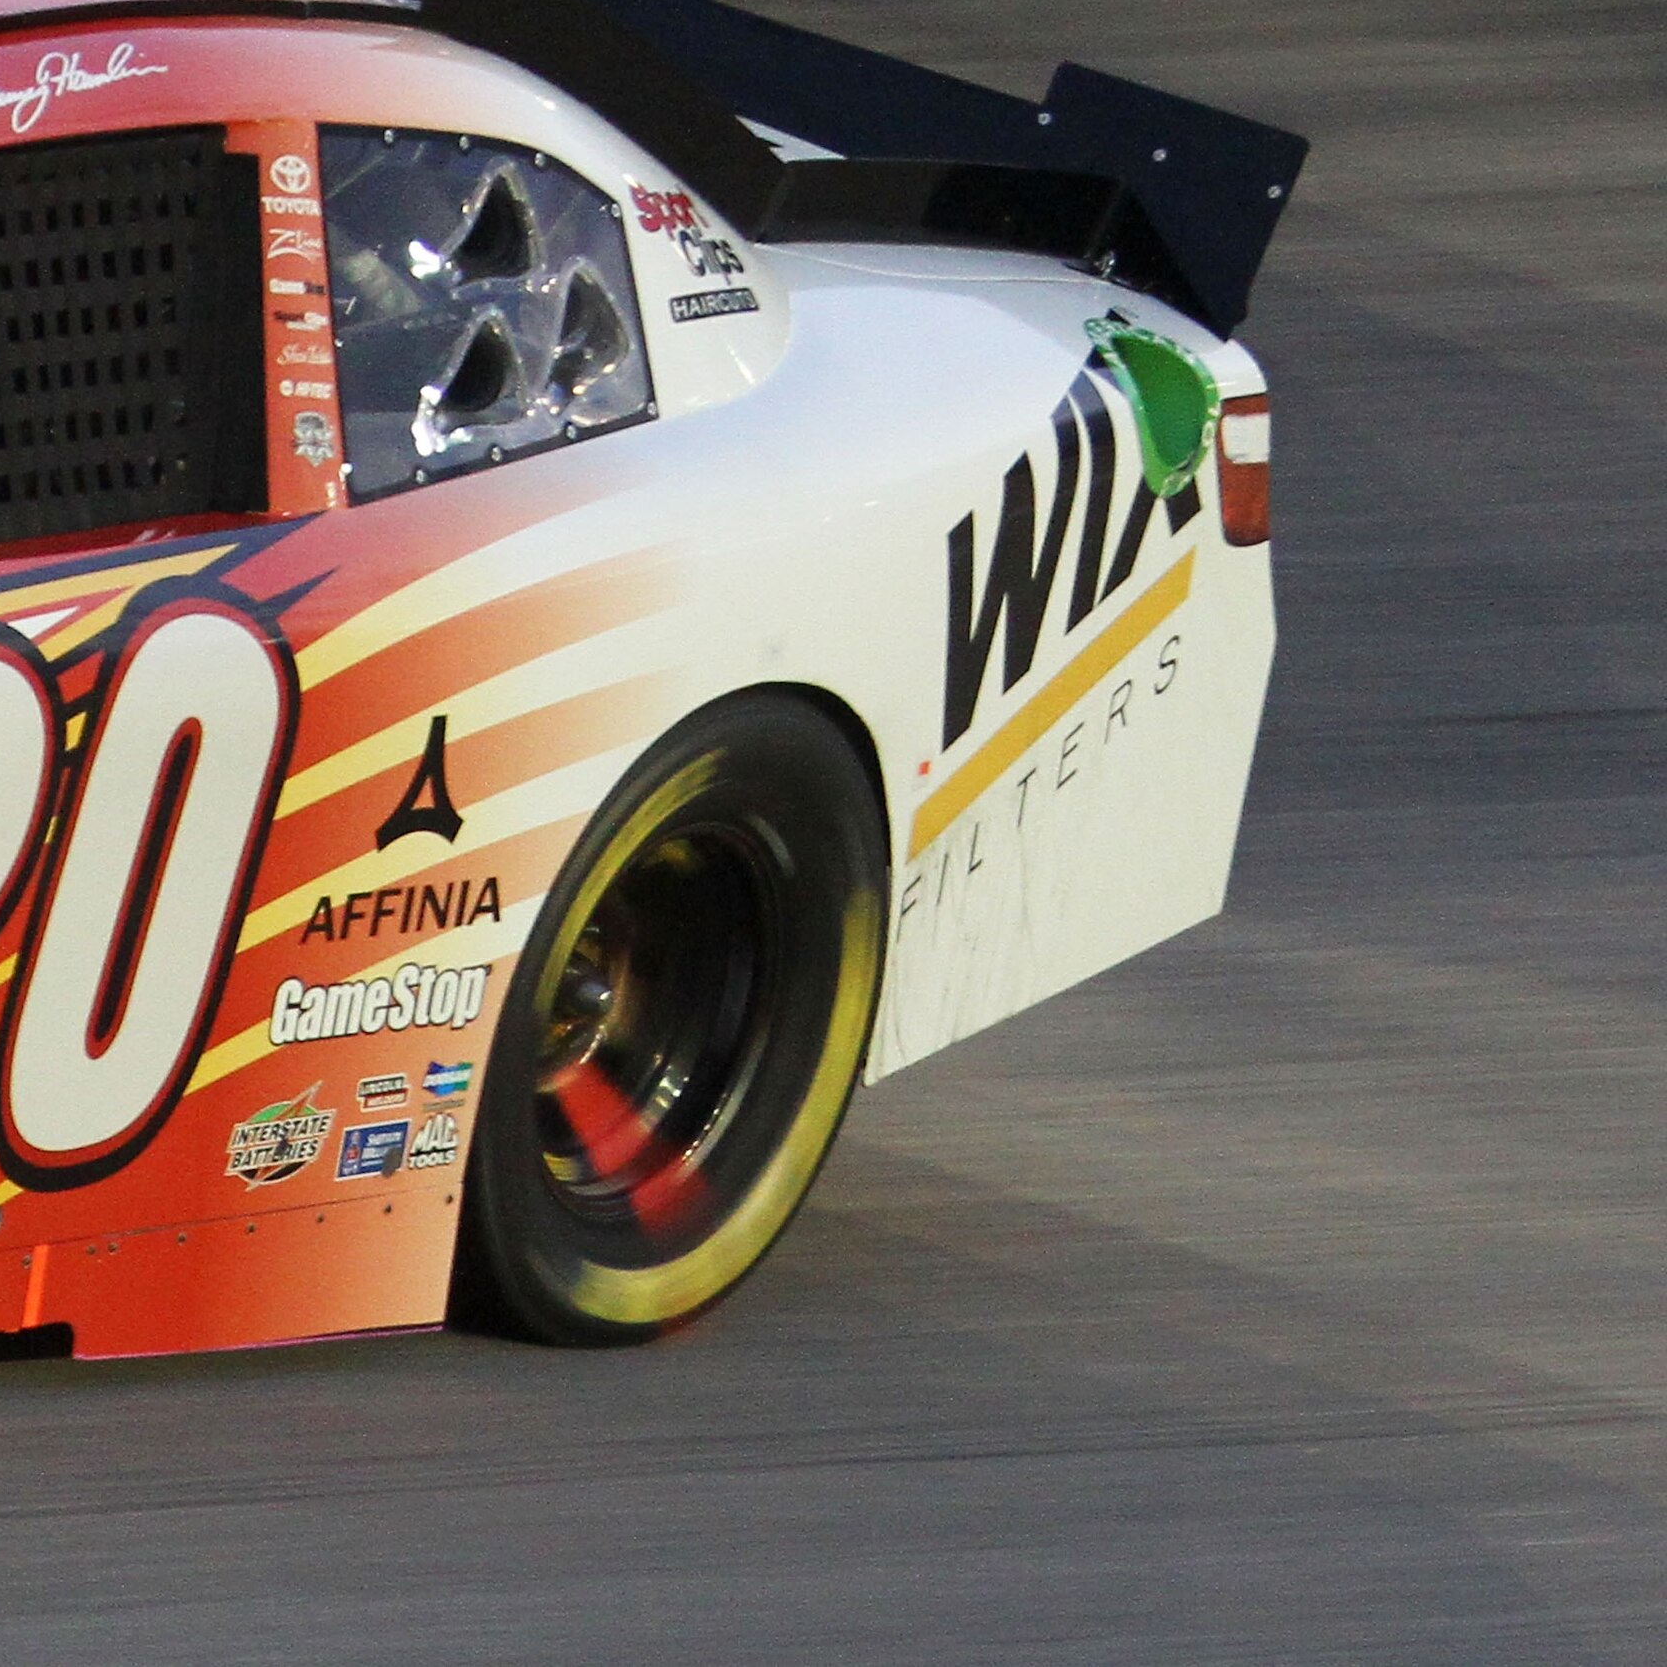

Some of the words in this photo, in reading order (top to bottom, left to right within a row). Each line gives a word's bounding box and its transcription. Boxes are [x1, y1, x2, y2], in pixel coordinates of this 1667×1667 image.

[260, 195, 322, 217] TOYOTA
[897, 634, 1183, 944] FILTERS
[301, 877, 503, 946] AFFINIA
[269, 963, 491, 1046] GameStop
[230, 1115, 331, 1147] INTERSTATE
[409, 1113, 458, 1154] MAC
[407, 1150, 457, 1169] TOOLS
